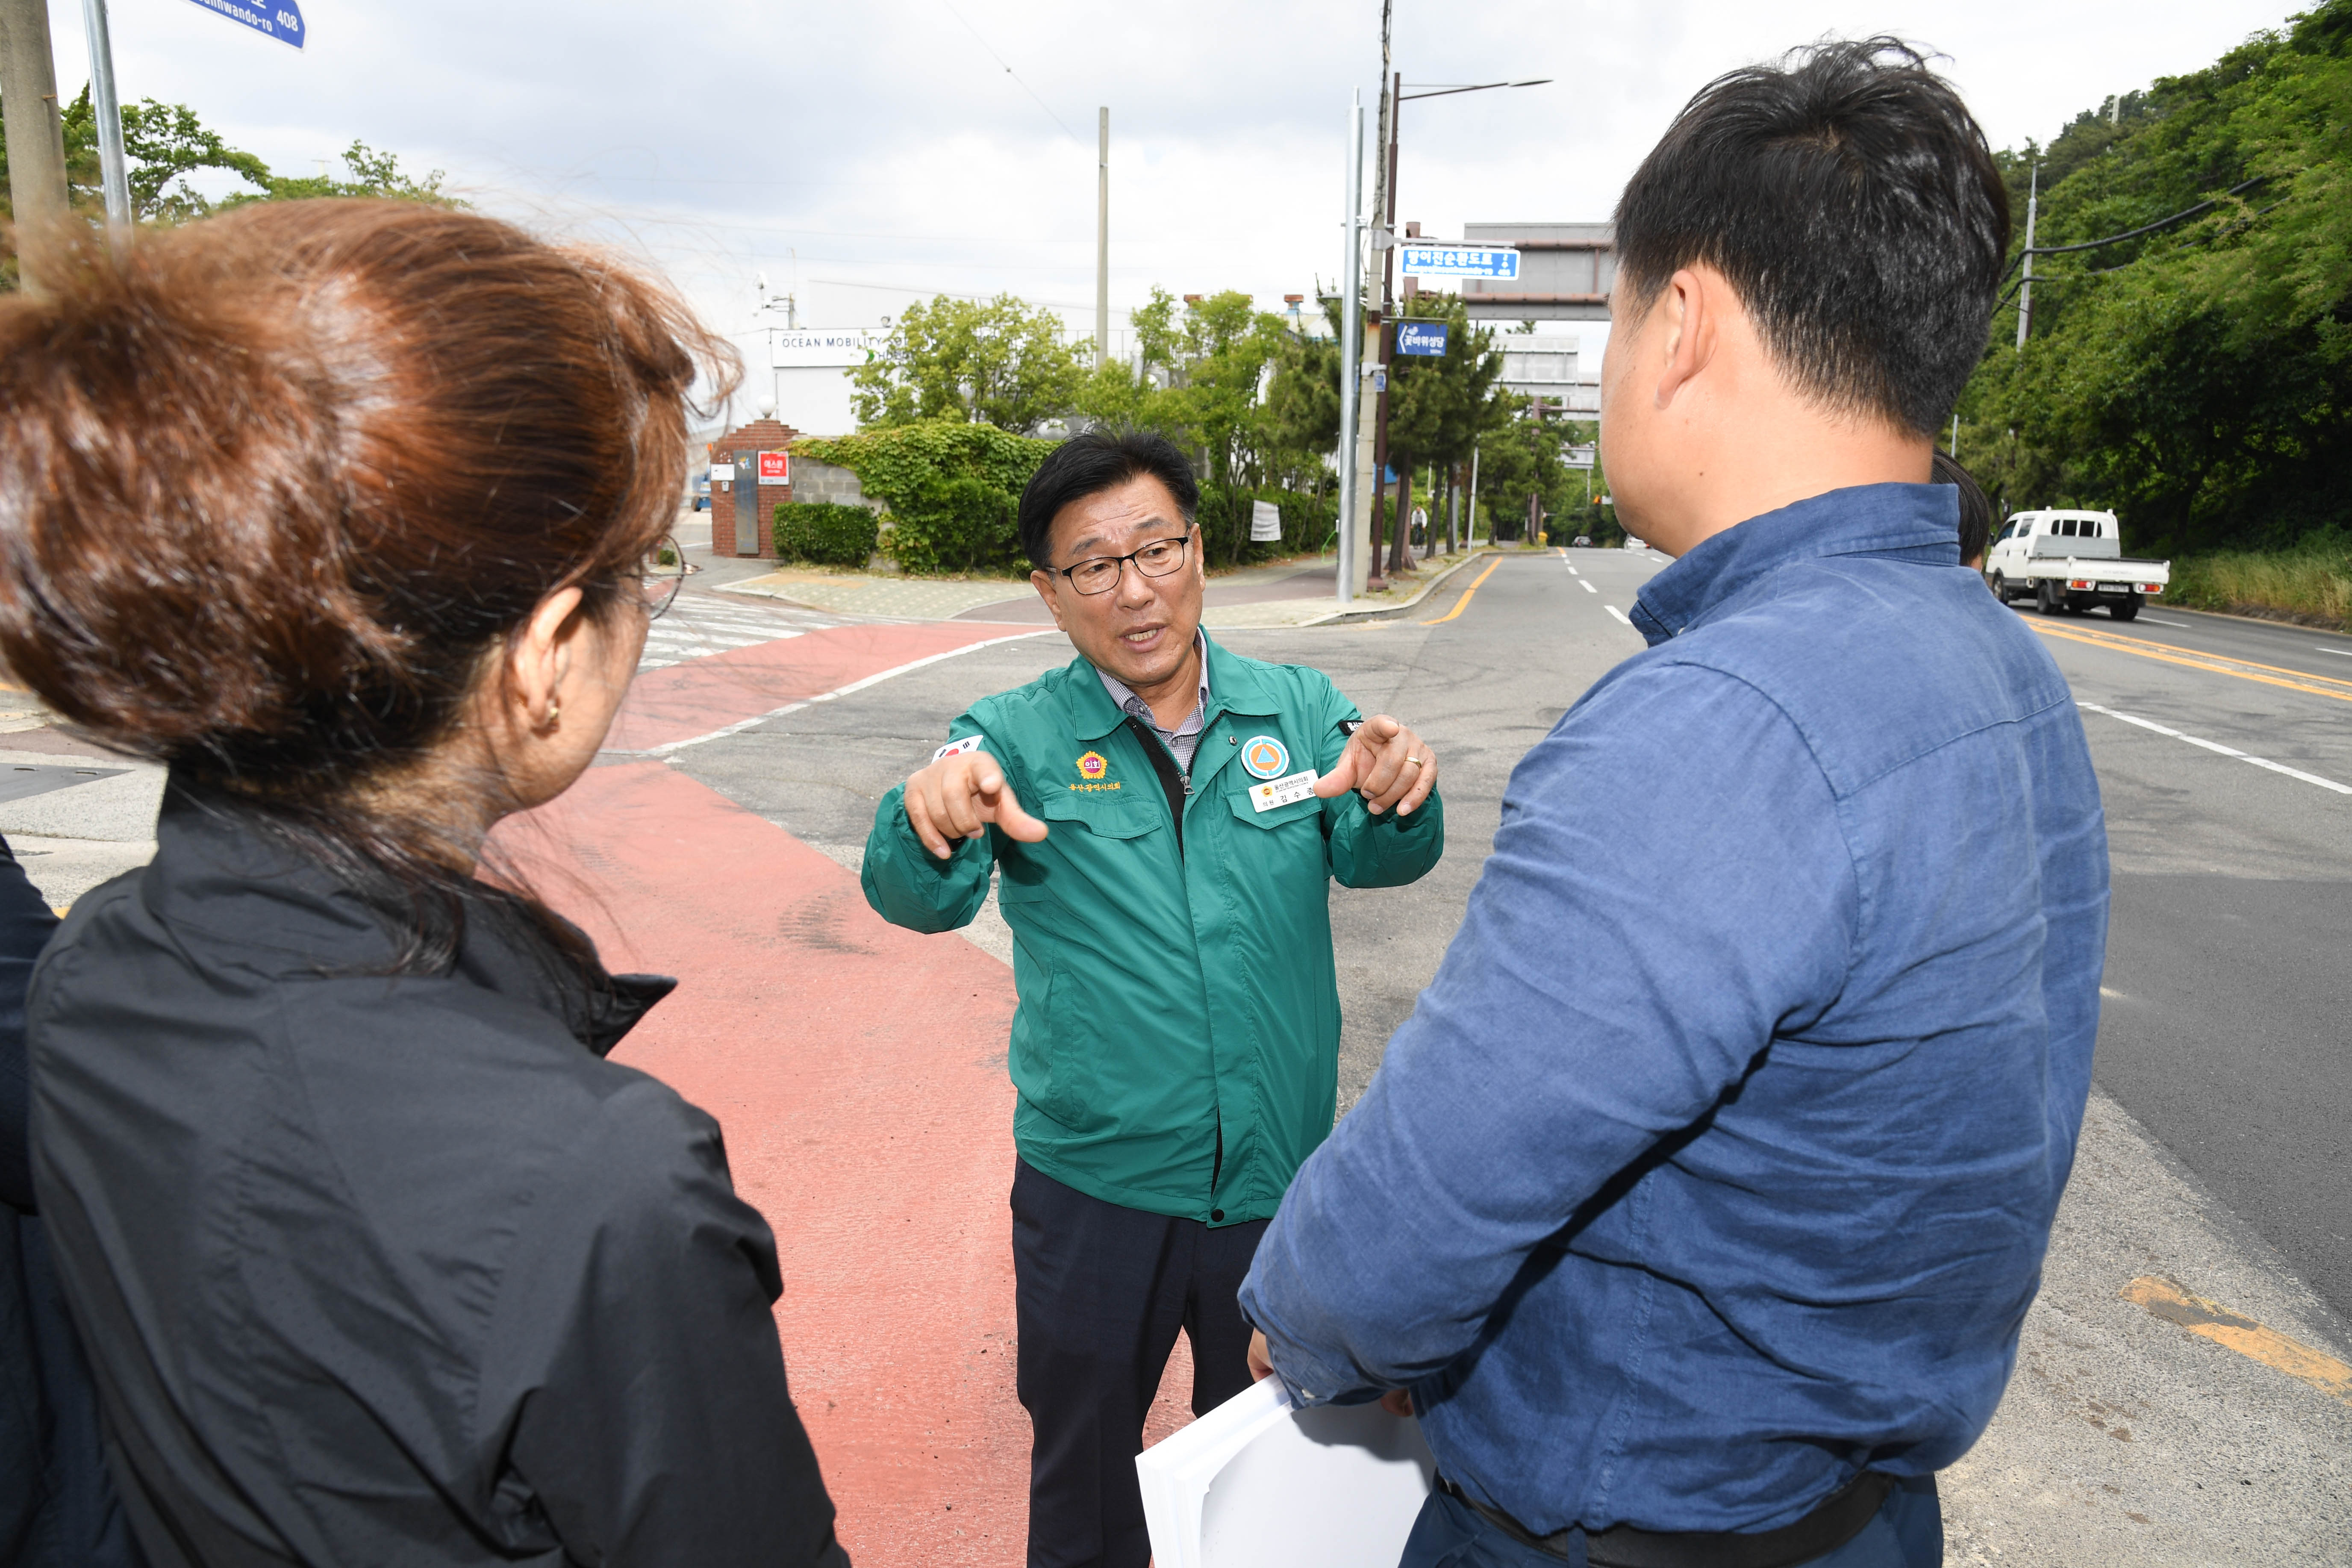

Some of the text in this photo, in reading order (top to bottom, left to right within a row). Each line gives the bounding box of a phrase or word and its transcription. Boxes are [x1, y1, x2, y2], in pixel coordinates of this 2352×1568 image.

[277, 9, 298, 32] 408
[783, 338, 820, 347] OCEAN
[827, 337, 882, 347] MOBILITY
[1084, 760, 1101, 769] 의회
[1069, 781, 1121, 792] 울산광역시의회
[1274, 776, 1308, 790] 울산광역시의회
